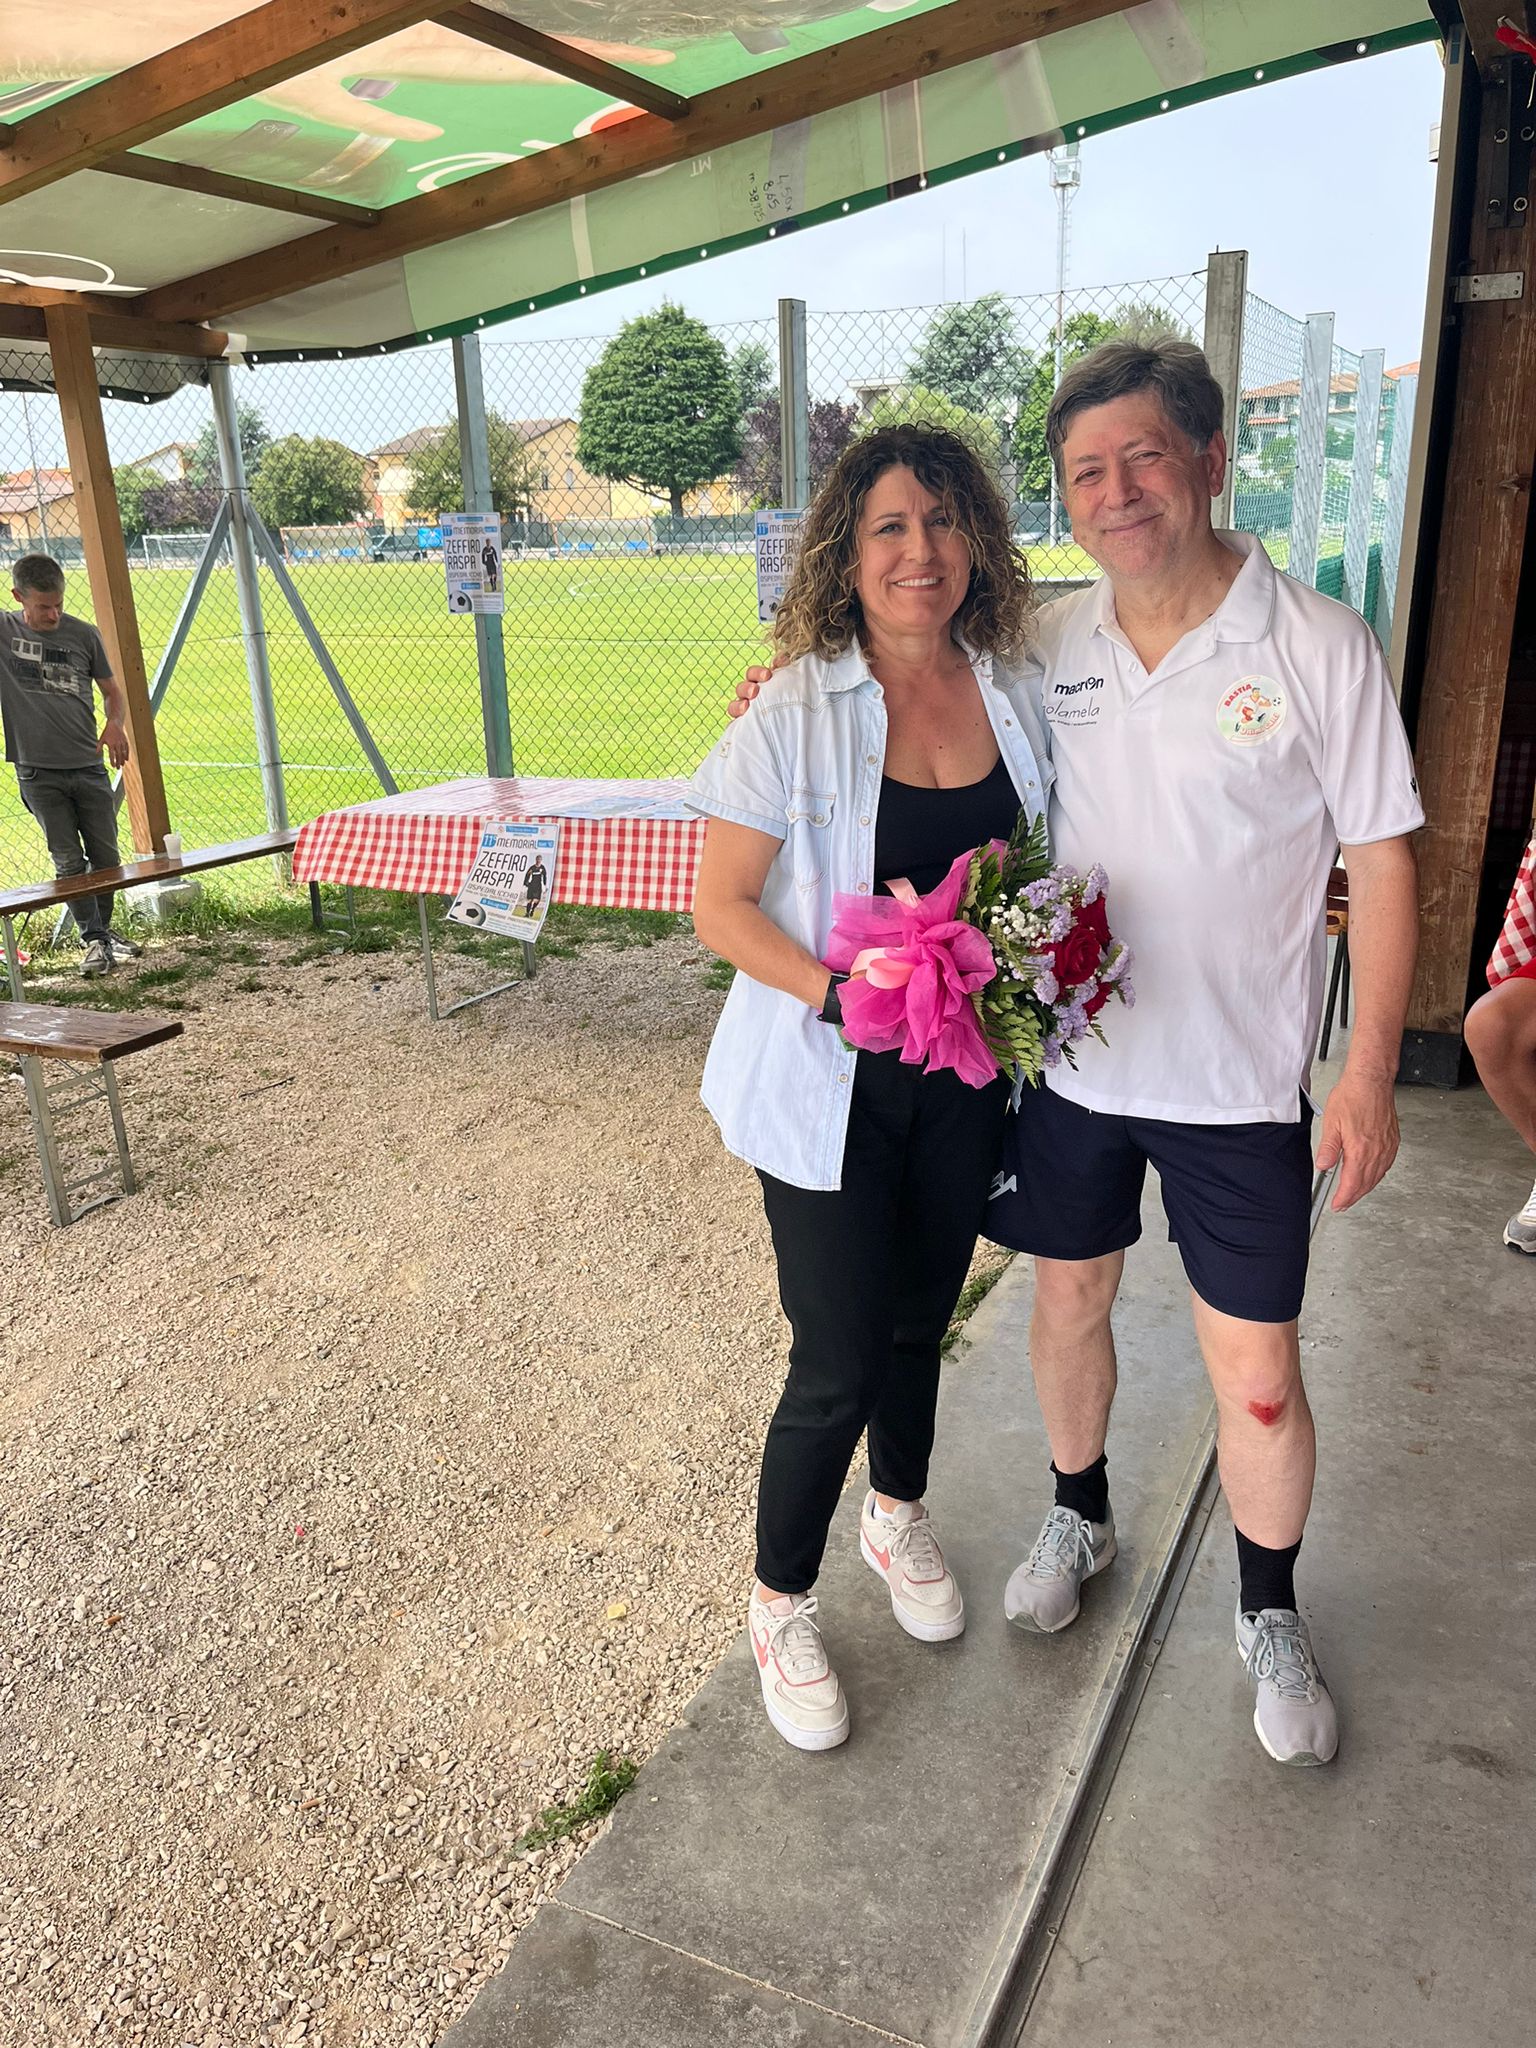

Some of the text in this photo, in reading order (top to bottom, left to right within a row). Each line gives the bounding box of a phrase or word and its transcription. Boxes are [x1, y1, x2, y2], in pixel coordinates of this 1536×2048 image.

[446, 539, 481, 554] ZEFFIRO
[447, 555, 477, 570] RASPA
[760, 557, 793, 573] RASPA
[1054, 677, 1104, 695] macron
[1224, 683, 1252, 707] BASTIA
[497, 838, 538, 849] MEMORIAL
[479, 851, 528, 872] ZEFFIRO
[472, 868, 515, 889] RASPA
